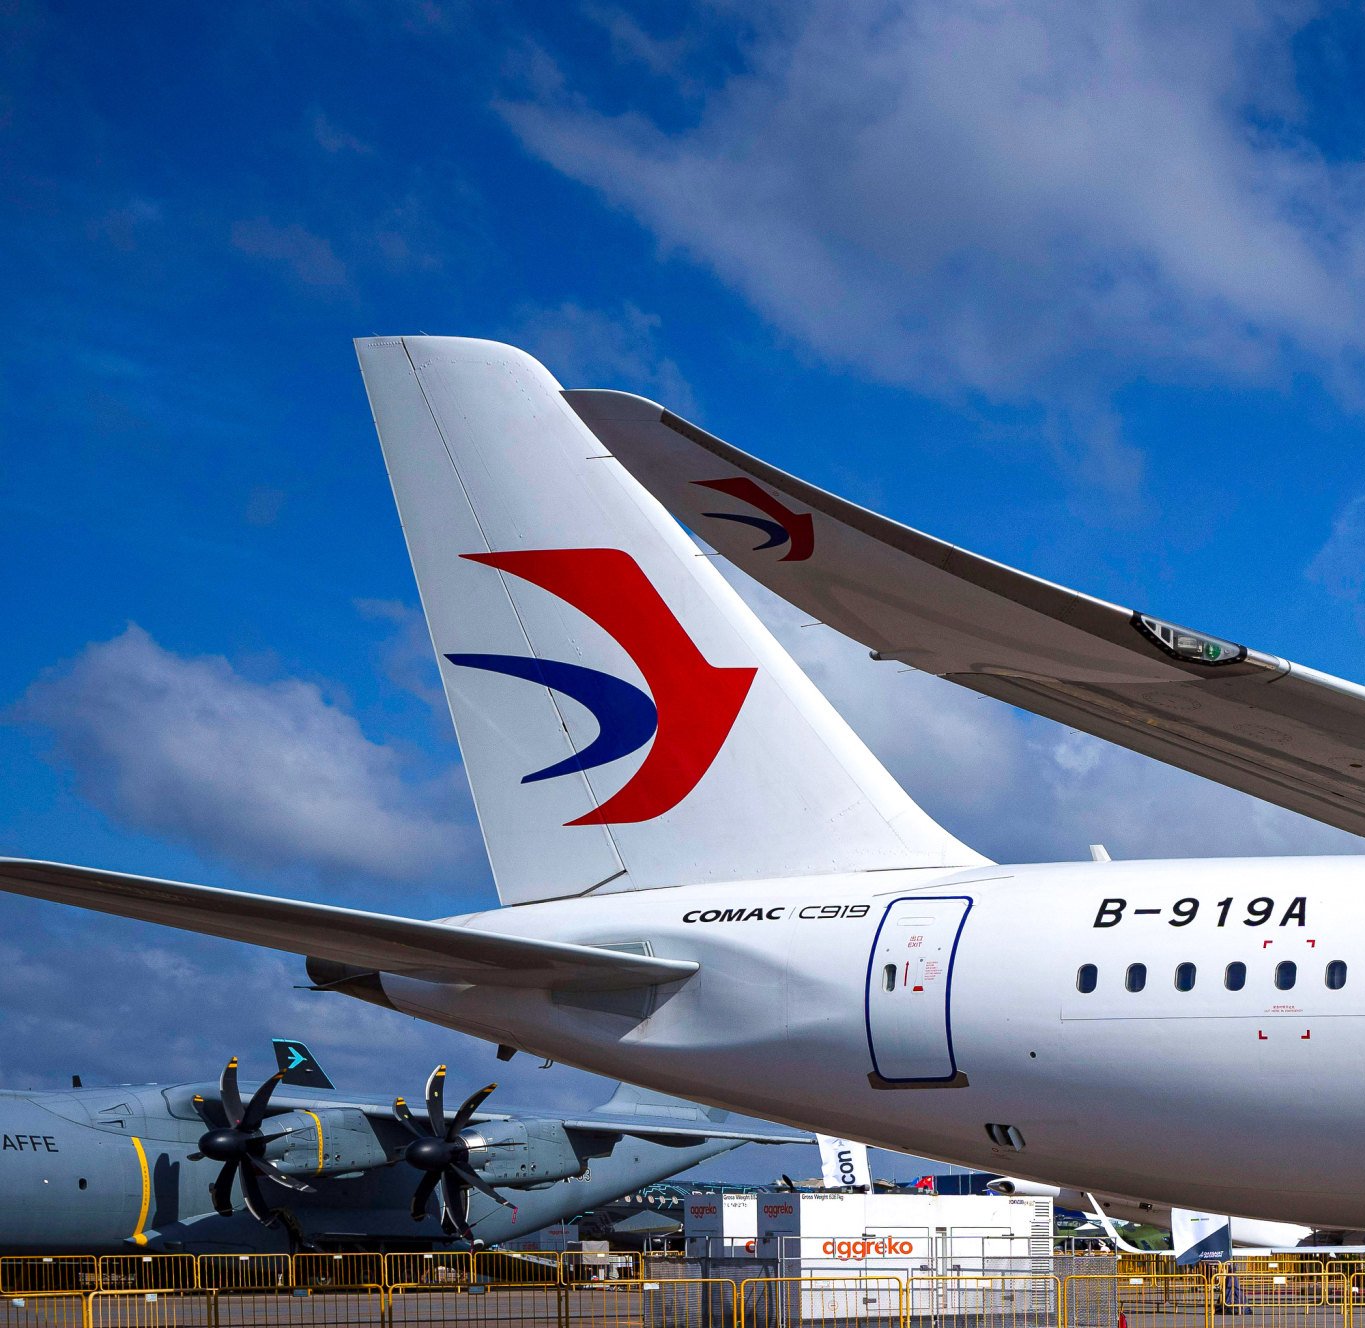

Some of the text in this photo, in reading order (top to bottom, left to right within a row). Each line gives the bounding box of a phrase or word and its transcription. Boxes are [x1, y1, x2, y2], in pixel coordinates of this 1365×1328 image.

[682, 904, 871, 924] COMAC C919
[1094, 898, 1308, 929] B-919A
[3, 1134, 59, 1153] AFFE
[691, 1203, 717, 1218] aggreko
[764, 1201, 793, 1218] aggreko
[823, 1235, 913, 1261] aggreko
